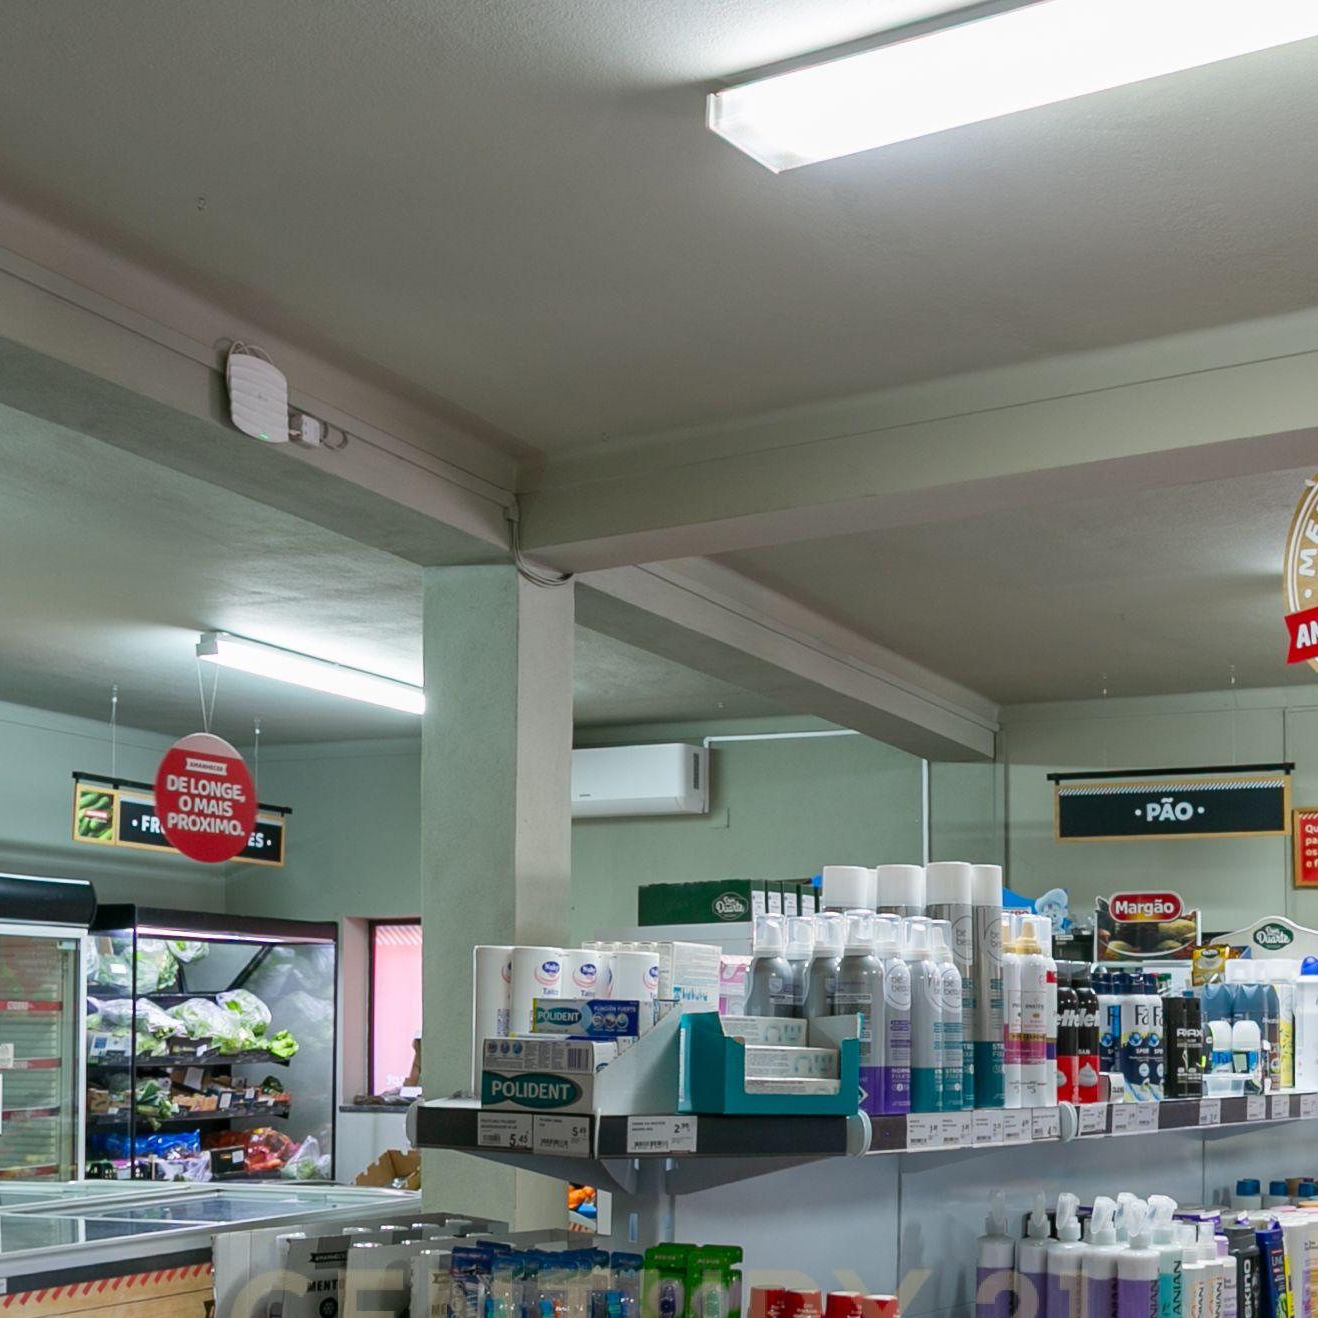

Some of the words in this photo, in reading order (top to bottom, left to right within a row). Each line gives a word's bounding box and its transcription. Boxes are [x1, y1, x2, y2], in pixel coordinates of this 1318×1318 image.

[166, 774, 188, 792] DE
[189, 777, 246, 803] LONGE,
[178, 795, 192, 812] O
[194, 797, 233, 817] MAIS
[1146, 797, 1194, 822] PÃO
[1306, 848, 1318, 857] os
[1306, 860, 1313, 868] e
[1115, 899, 1175, 917] Margão
[1256, 933, 1290, 946] Duarte
[537, 1010, 580, 1022] POLIDENT
[491, 1080, 571, 1100] POLIDENT
[1173, 1260, 1182, 1316] ANIAN
